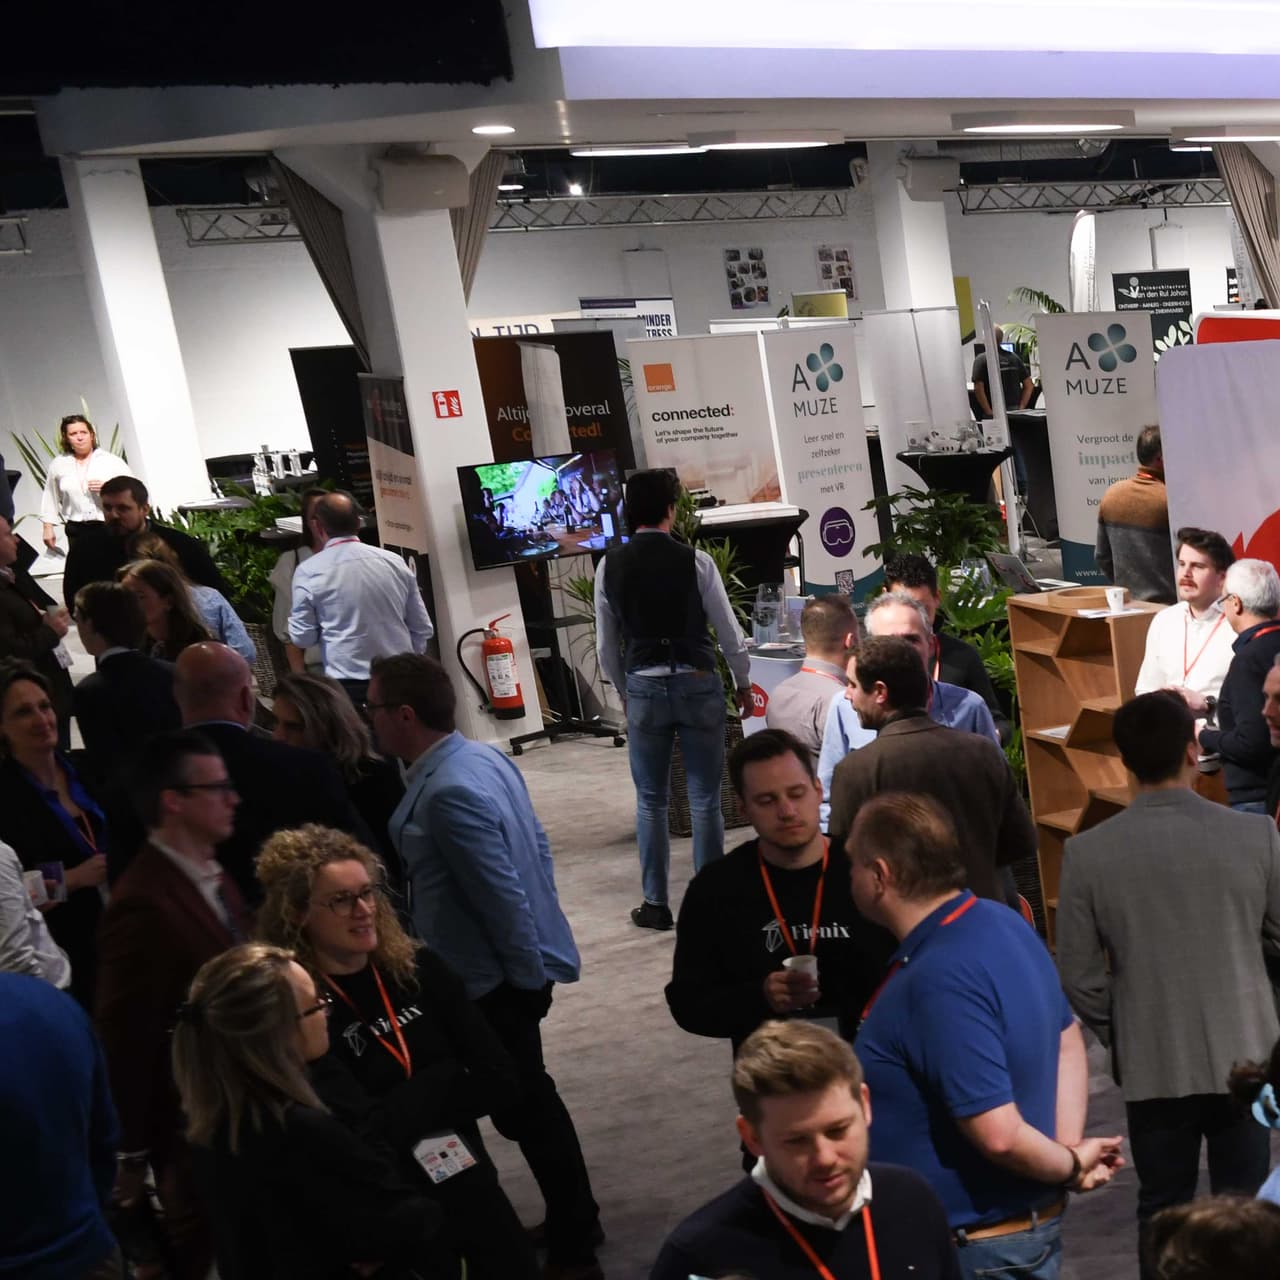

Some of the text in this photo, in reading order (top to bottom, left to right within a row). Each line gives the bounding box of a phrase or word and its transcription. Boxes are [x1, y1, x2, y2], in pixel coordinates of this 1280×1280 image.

[1066, 377, 1128, 396] MUZE
[497, 405, 531, 423] Altij
[652, 403, 735, 422] connected:
[793, 397, 839, 418] MUZE
[672, 428, 692, 436] shape
[680, 434, 710, 442] company
[710, 432, 738, 440] together
[804, 434, 819, 444] Leer
[820, 432, 834, 442] snel
[1077, 433, 1134, 446] Vergroot de
[1079, 451, 1136, 469] impact
[1088, 477, 1106, 485] van
[820, 482, 845, 494] met VR
